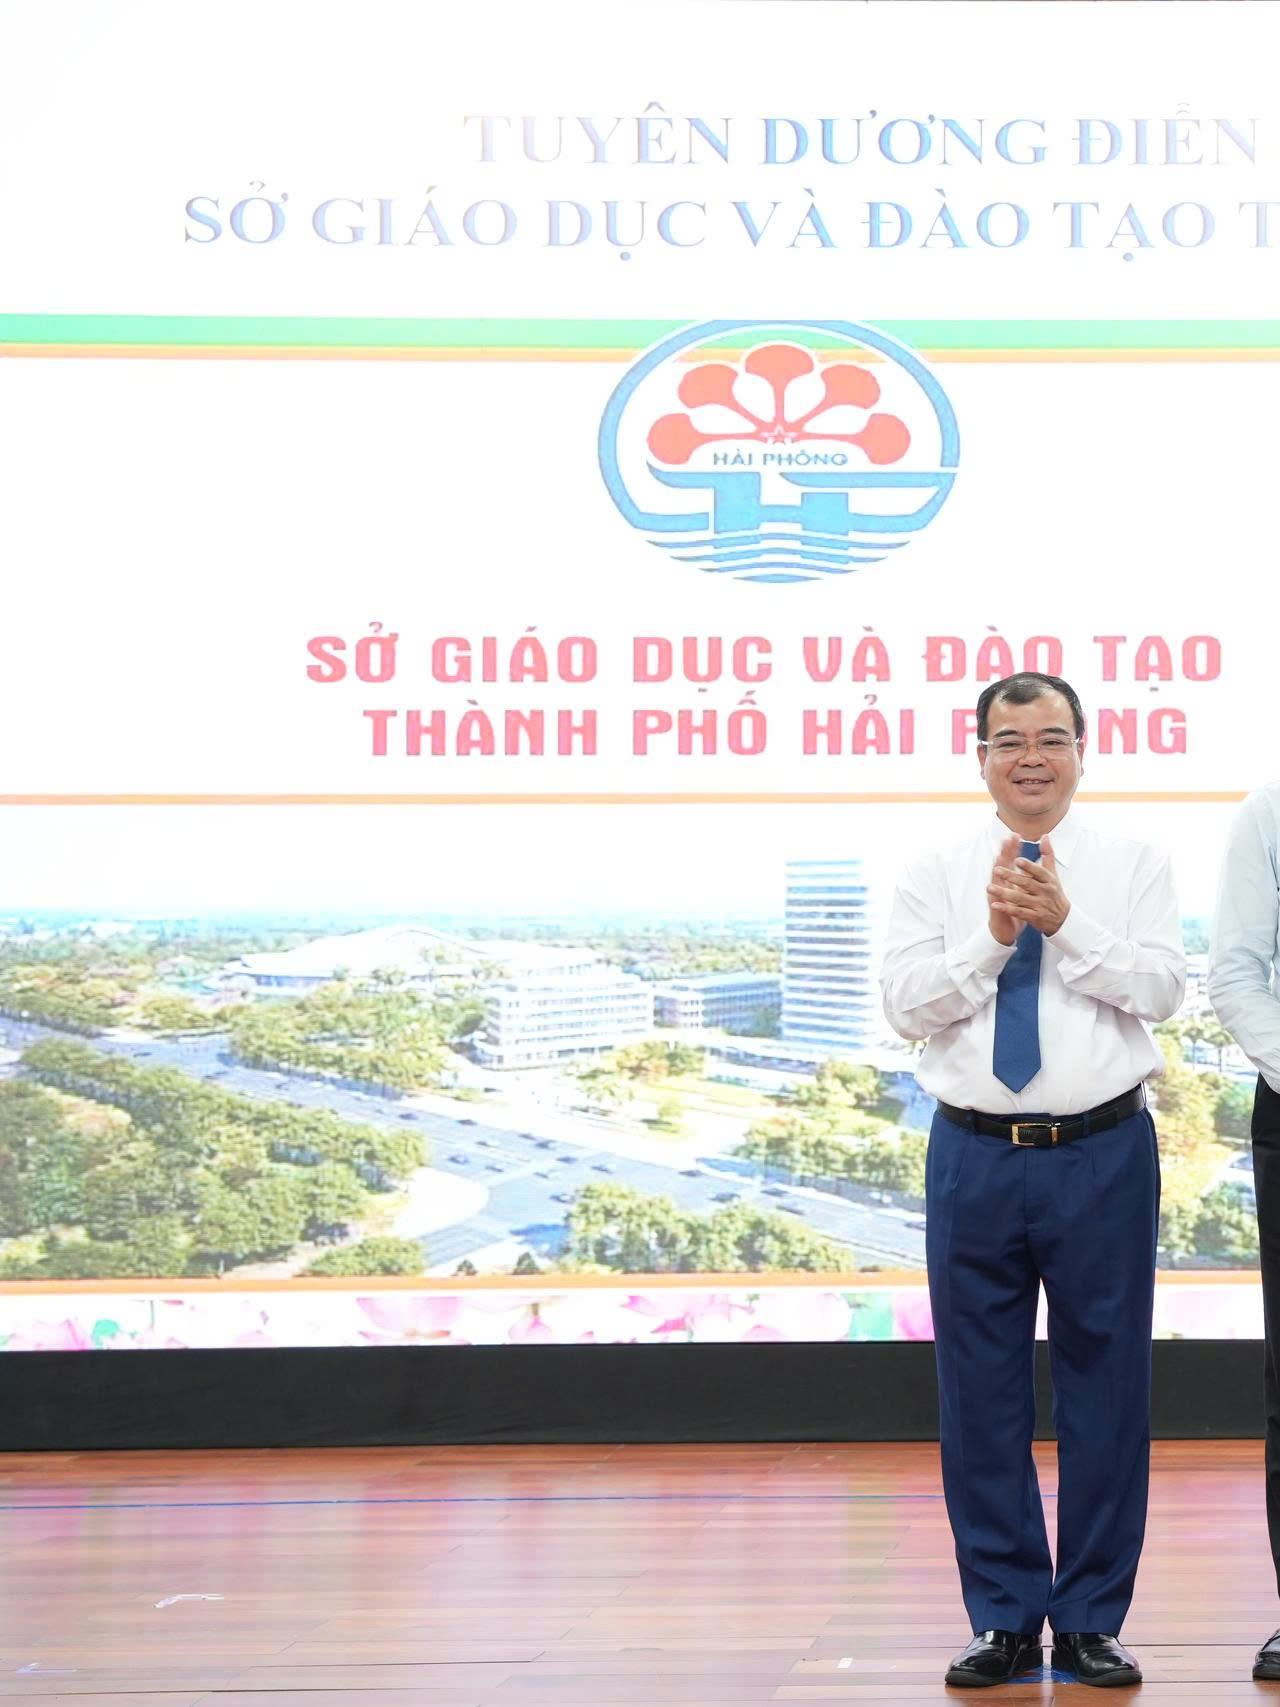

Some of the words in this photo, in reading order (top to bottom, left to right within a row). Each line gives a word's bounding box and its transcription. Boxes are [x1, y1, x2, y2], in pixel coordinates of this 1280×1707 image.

[463, 101, 732, 165] TUYÊN
[760, 109, 1048, 166] DƯƠNG
[184, 180, 289, 245] SỞ
[311, 184, 517, 247] GIÁO
[543, 199, 707, 262] DỤC
[730, 187, 838, 249] VÀ
[860, 187, 1031, 249] ĐÀO
[1051, 200, 1216, 263] TẠO
[304, 621, 400, 684] SỞ
[430, 626, 598, 684] GIÁO
[632, 635, 773, 693] DỤC
[802, 626, 891, 684] VÀ
[921, 625, 1064, 682] ĐÀO
[1092, 635, 1223, 692] TẠO
[362, 699, 598, 757] THÀNH
[632, 690, 768, 757] PHỐ
[802, 694, 915, 756] HẢI
[951, 706, 1187, 756] PNG
